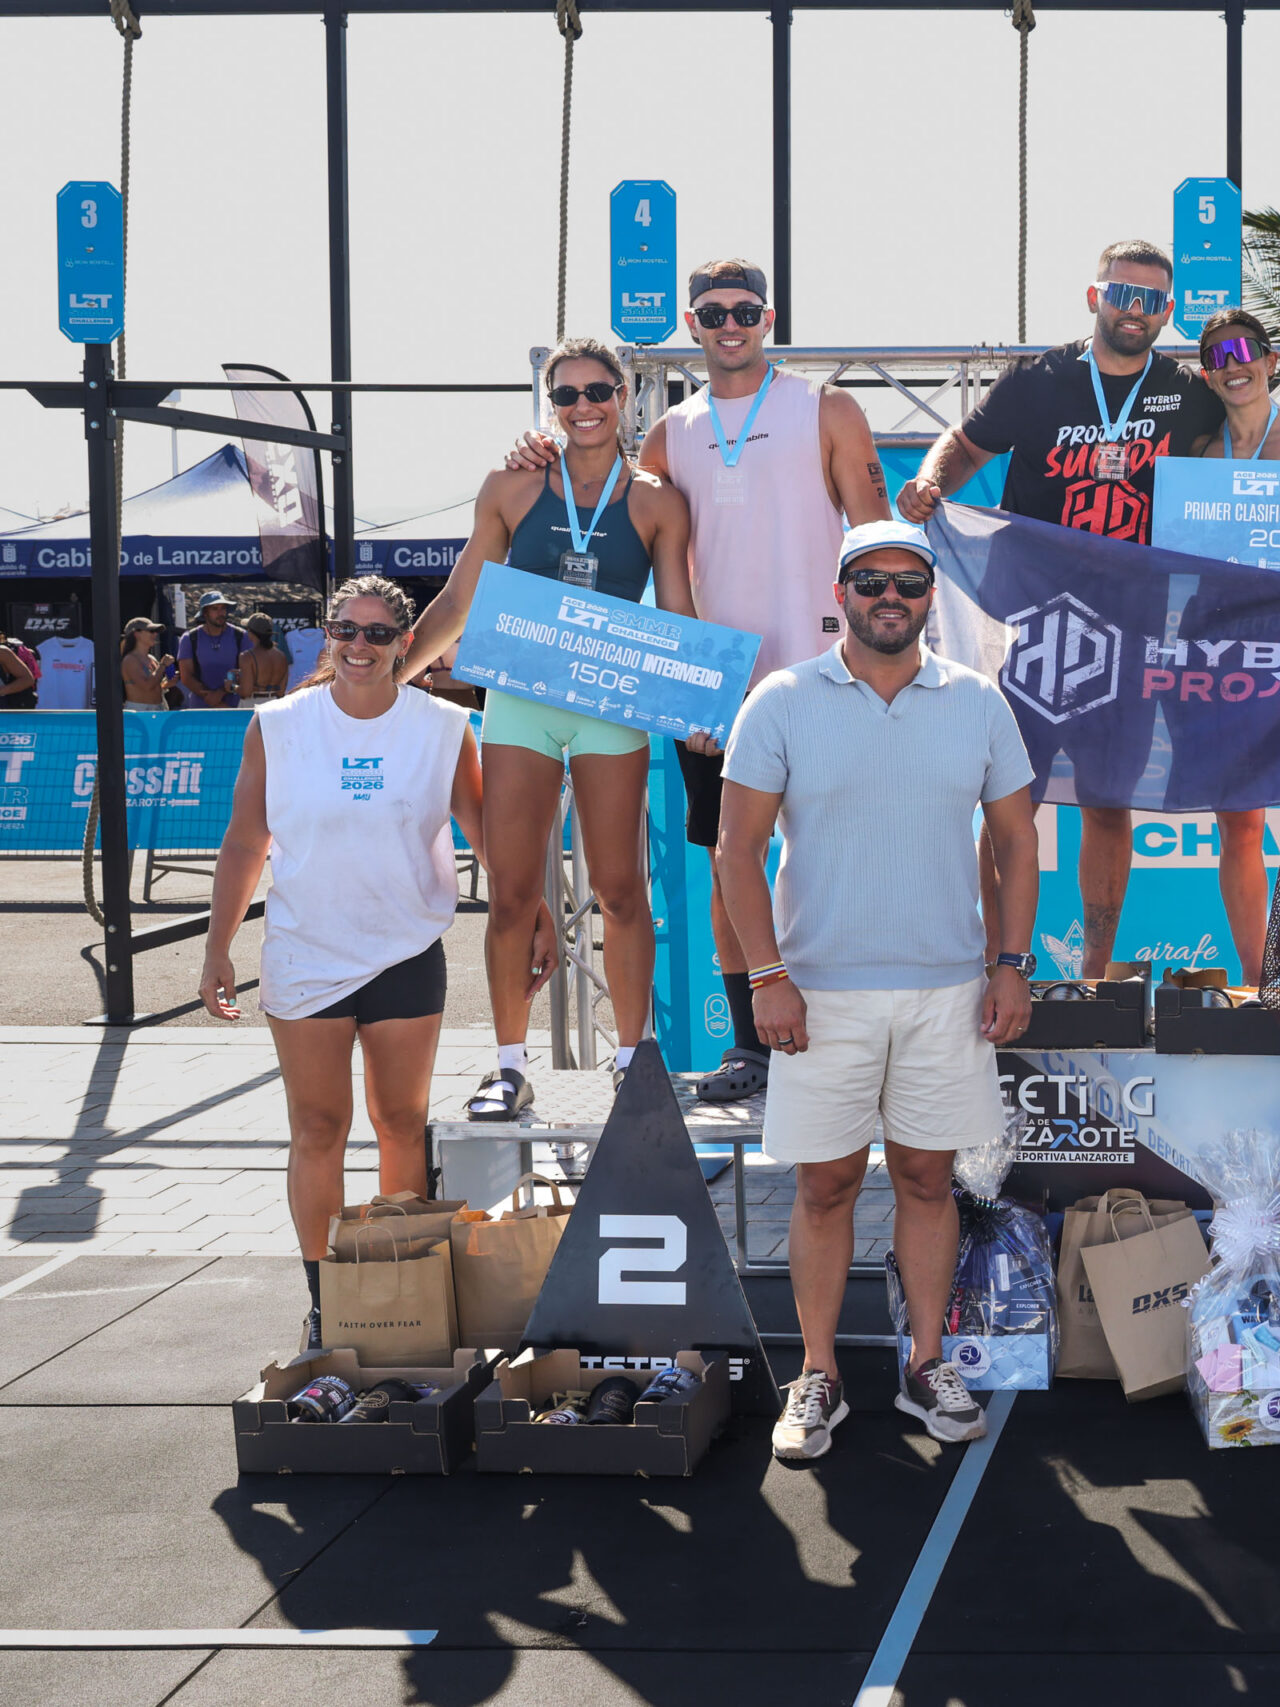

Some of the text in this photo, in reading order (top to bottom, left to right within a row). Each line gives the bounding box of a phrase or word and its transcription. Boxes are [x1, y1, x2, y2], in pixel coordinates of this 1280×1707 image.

[81, 200, 97, 228] 3
[634, 199, 652, 227] 4
[1198, 196, 1216, 224] 5
[1143, 394, 1182, 405] HYBRID
[1143, 403, 1181, 413] PROJECT
[1233, 480, 1279, 496] LZT
[1184, 501, 1231, 521] PRIMER
[38, 548, 128, 568] Cabio
[133, 552, 153, 565] de
[394, 547, 461, 567] Cabil
[557, 605, 609, 630] LZT
[611, 610, 682, 639] SMMR
[611, 627, 675, 648] CHALLENGE
[496, 613, 723, 690] SEGUNDO CLASIFICADO INTERMEDIO
[569, 661, 640, 695] 150€
[0, 736, 31, 744] 026
[342, 757, 384, 769] LZT
[74, 761, 203, 796] CssFit
[341, 781, 384, 790] 2026
[1021, 1118, 1136, 1149] ZAROTE
[1016, 1153, 1129, 1162] EPORTIVA LANZAROTE
[598, 1214, 687, 1305] 2
[1132, 1282, 1188, 1314] DXS
